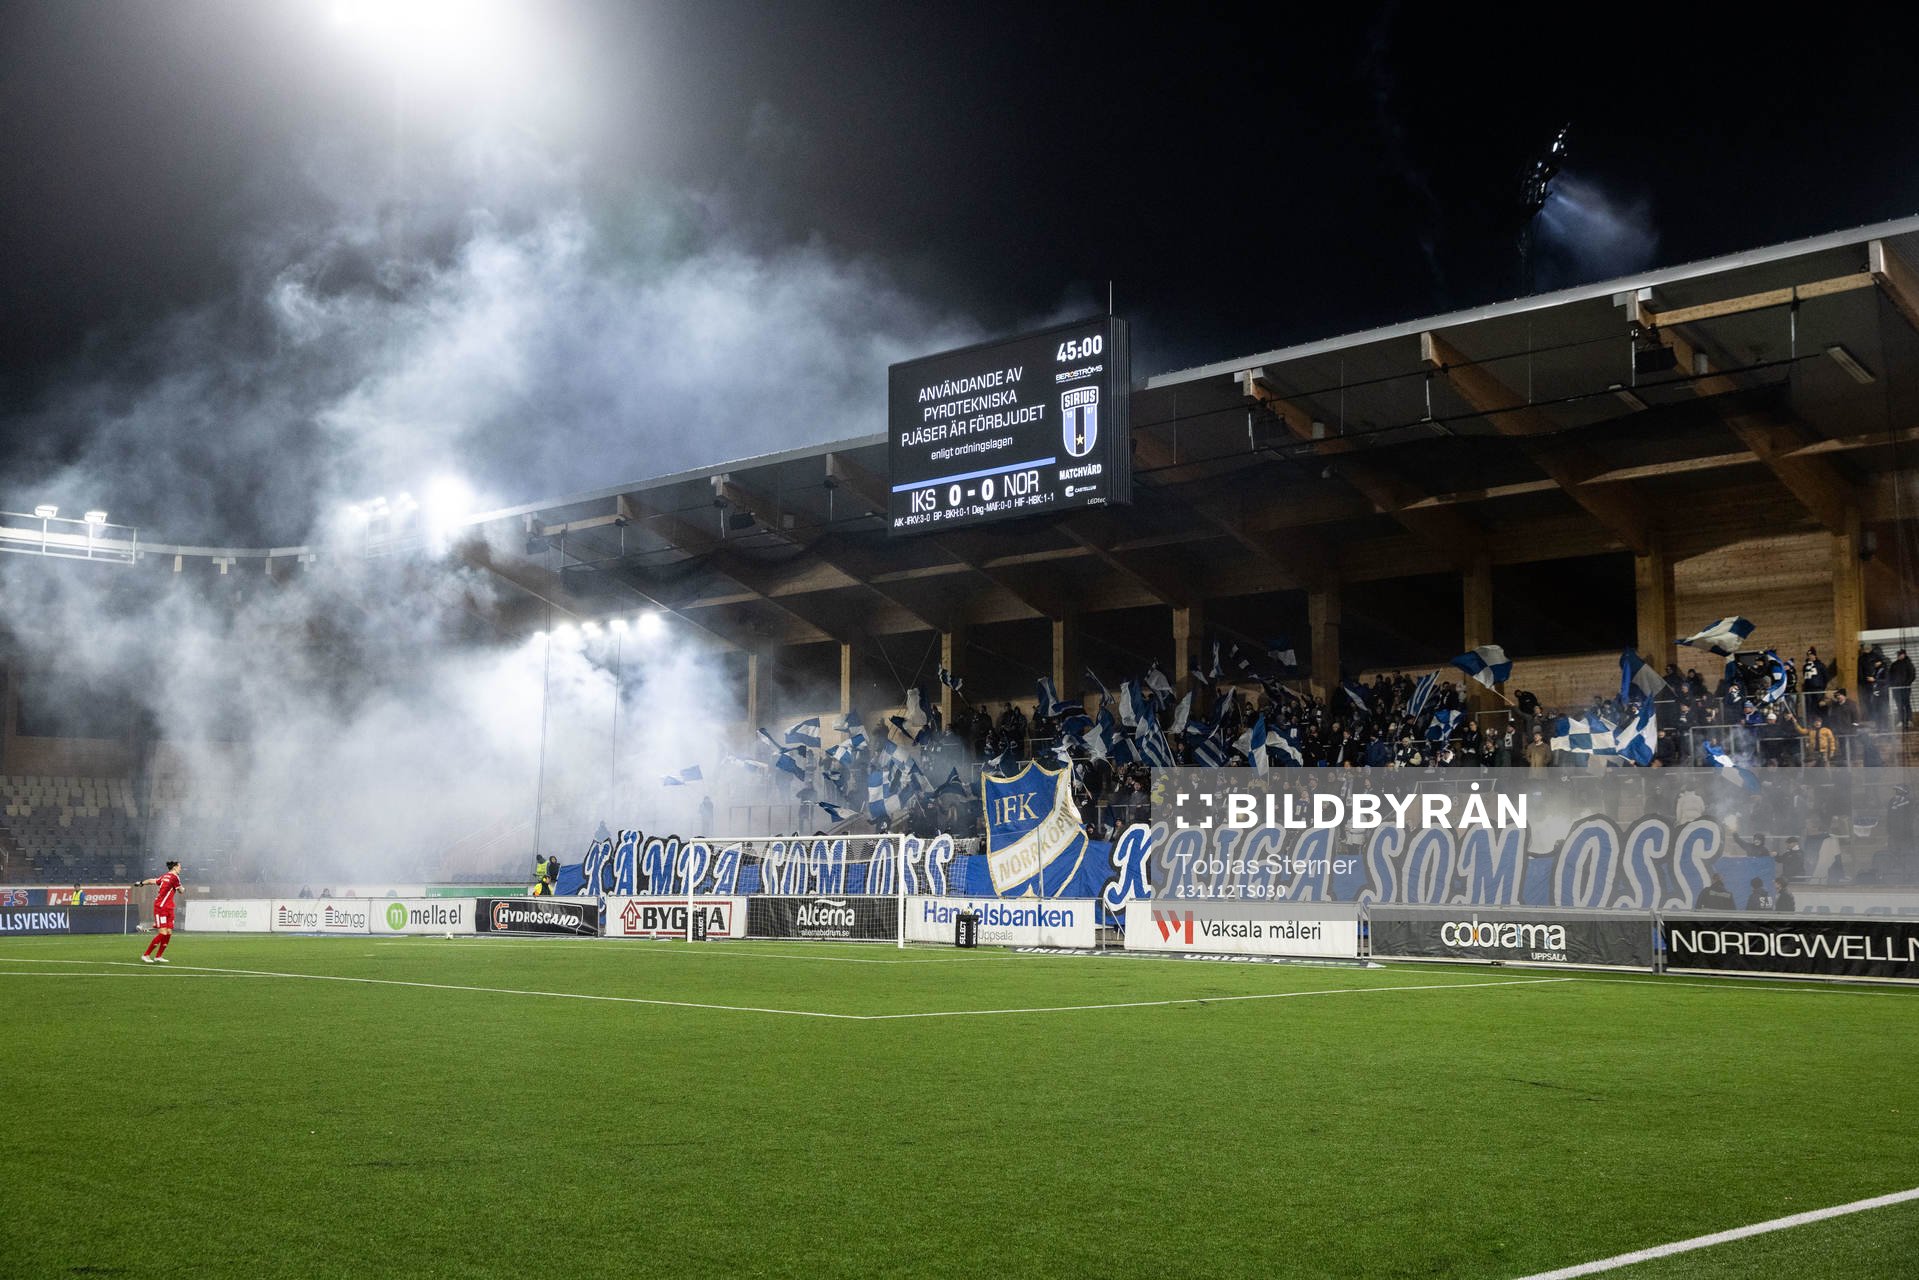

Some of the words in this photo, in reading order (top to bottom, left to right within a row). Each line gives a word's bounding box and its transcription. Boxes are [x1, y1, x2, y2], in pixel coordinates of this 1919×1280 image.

[1056, 335, 1103, 362] 45:00
[918, 371, 1004, 402] ANVÄNDANDE
[1006, 366, 1023, 382] AV
[924, 389, 1018, 422] PYROTEKNISKA
[1064, 389, 1096, 408] SIRIUS
[901, 424, 947, 447] PJÄSER
[949, 419, 967, 437] ÄR
[969, 404, 1046, 434] FÖRBJUDET
[931, 443, 954, 460] enligt
[955, 436, 1013, 457] ordningslagen
[1059, 463, 1102, 481] MATCHVÄRD
[912, 488, 936, 513] IKS
[949, 484, 961, 506] 0
[982, 478, 994, 501] 0
[1004, 470, 1039, 498] NOR
[993, 792, 1039, 826] IFK
[579, 829, 743, 898] KÄMPA
[760, 834, 848, 897] SOM
[865, 833, 955, 897] OSS
[1101, 823, 1336, 909] KRIGA
[1359, 821, 1525, 906] SOM
[1553, 818, 1723, 908] OSS
[287, 910, 318, 928] Botrygg
[334, 910, 365, 928] Botrygg
[643, 906, 726, 930] BYGA
[797, 902, 855, 926] Alterna
[923, 900, 1074, 928] Hanelsbanken
[959, 920, 967, 944] SELECT
[1200, 918, 1262, 939] Vaksala
[1269, 920, 1321, 940] måleri
[1440, 914, 1566, 950] colorama
[1531, 952, 1567, 961] UPPSALA
